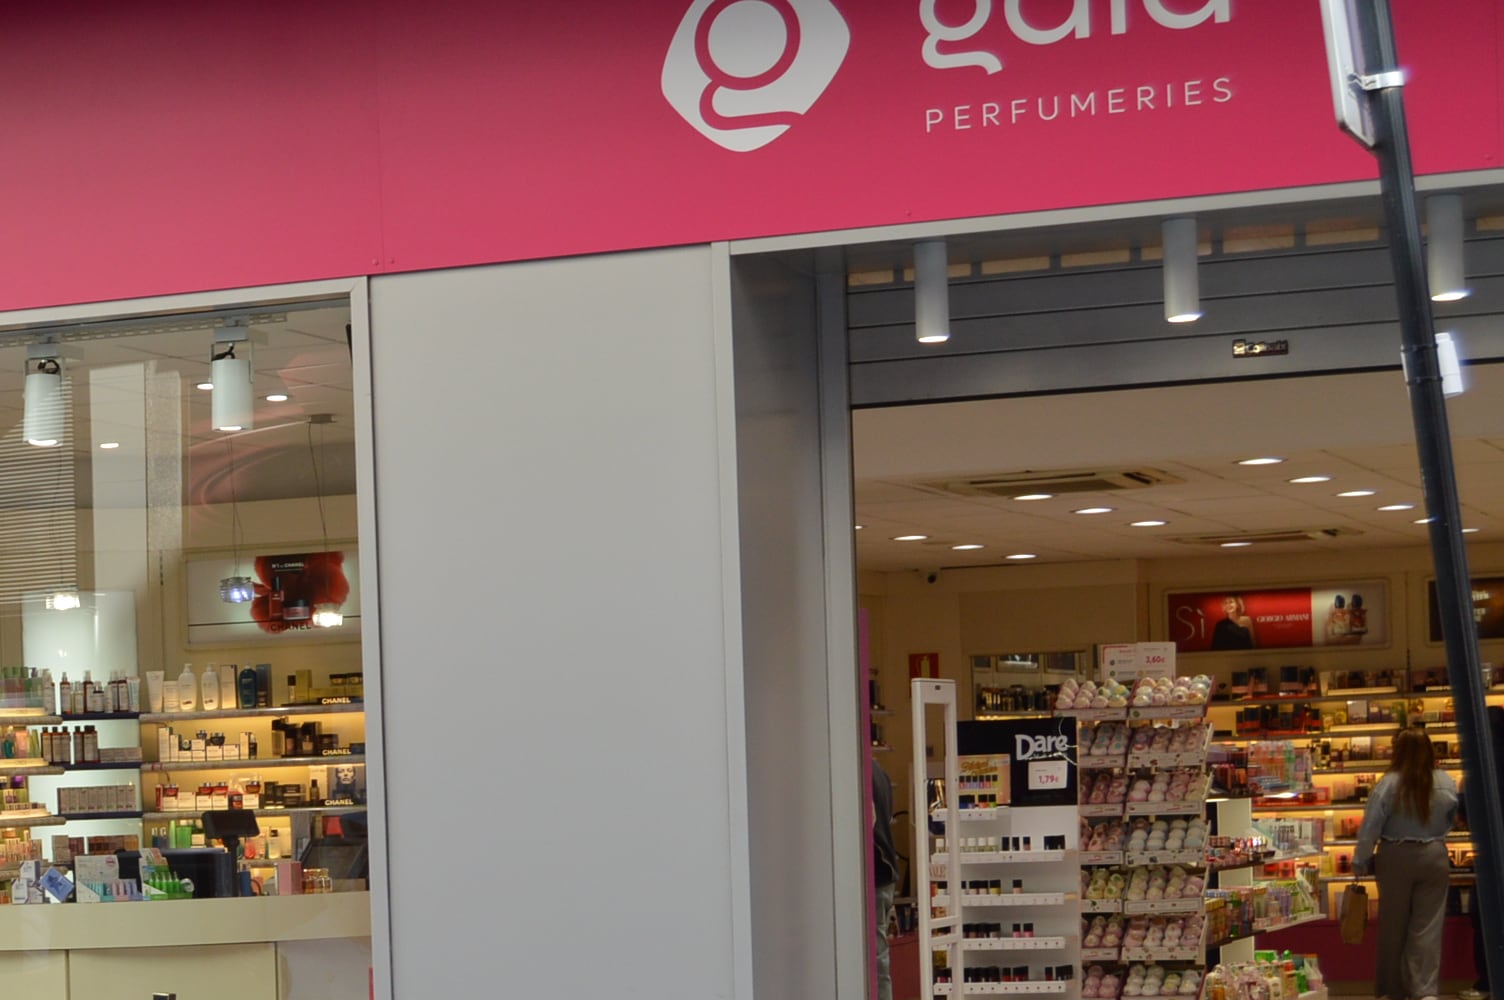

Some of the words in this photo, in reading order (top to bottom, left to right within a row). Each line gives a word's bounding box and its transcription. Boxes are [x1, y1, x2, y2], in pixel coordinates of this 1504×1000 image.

[925, 76, 1233, 133] PERFUMERIES
[1256, 614, 1284, 623] GIORGIO
[1285, 613, 1310, 621] ARMANI
[270, 623, 312, 632] CHANEL
[321, 697, 351, 705] CHANEL
[1014, 733, 1069, 761] Dare
